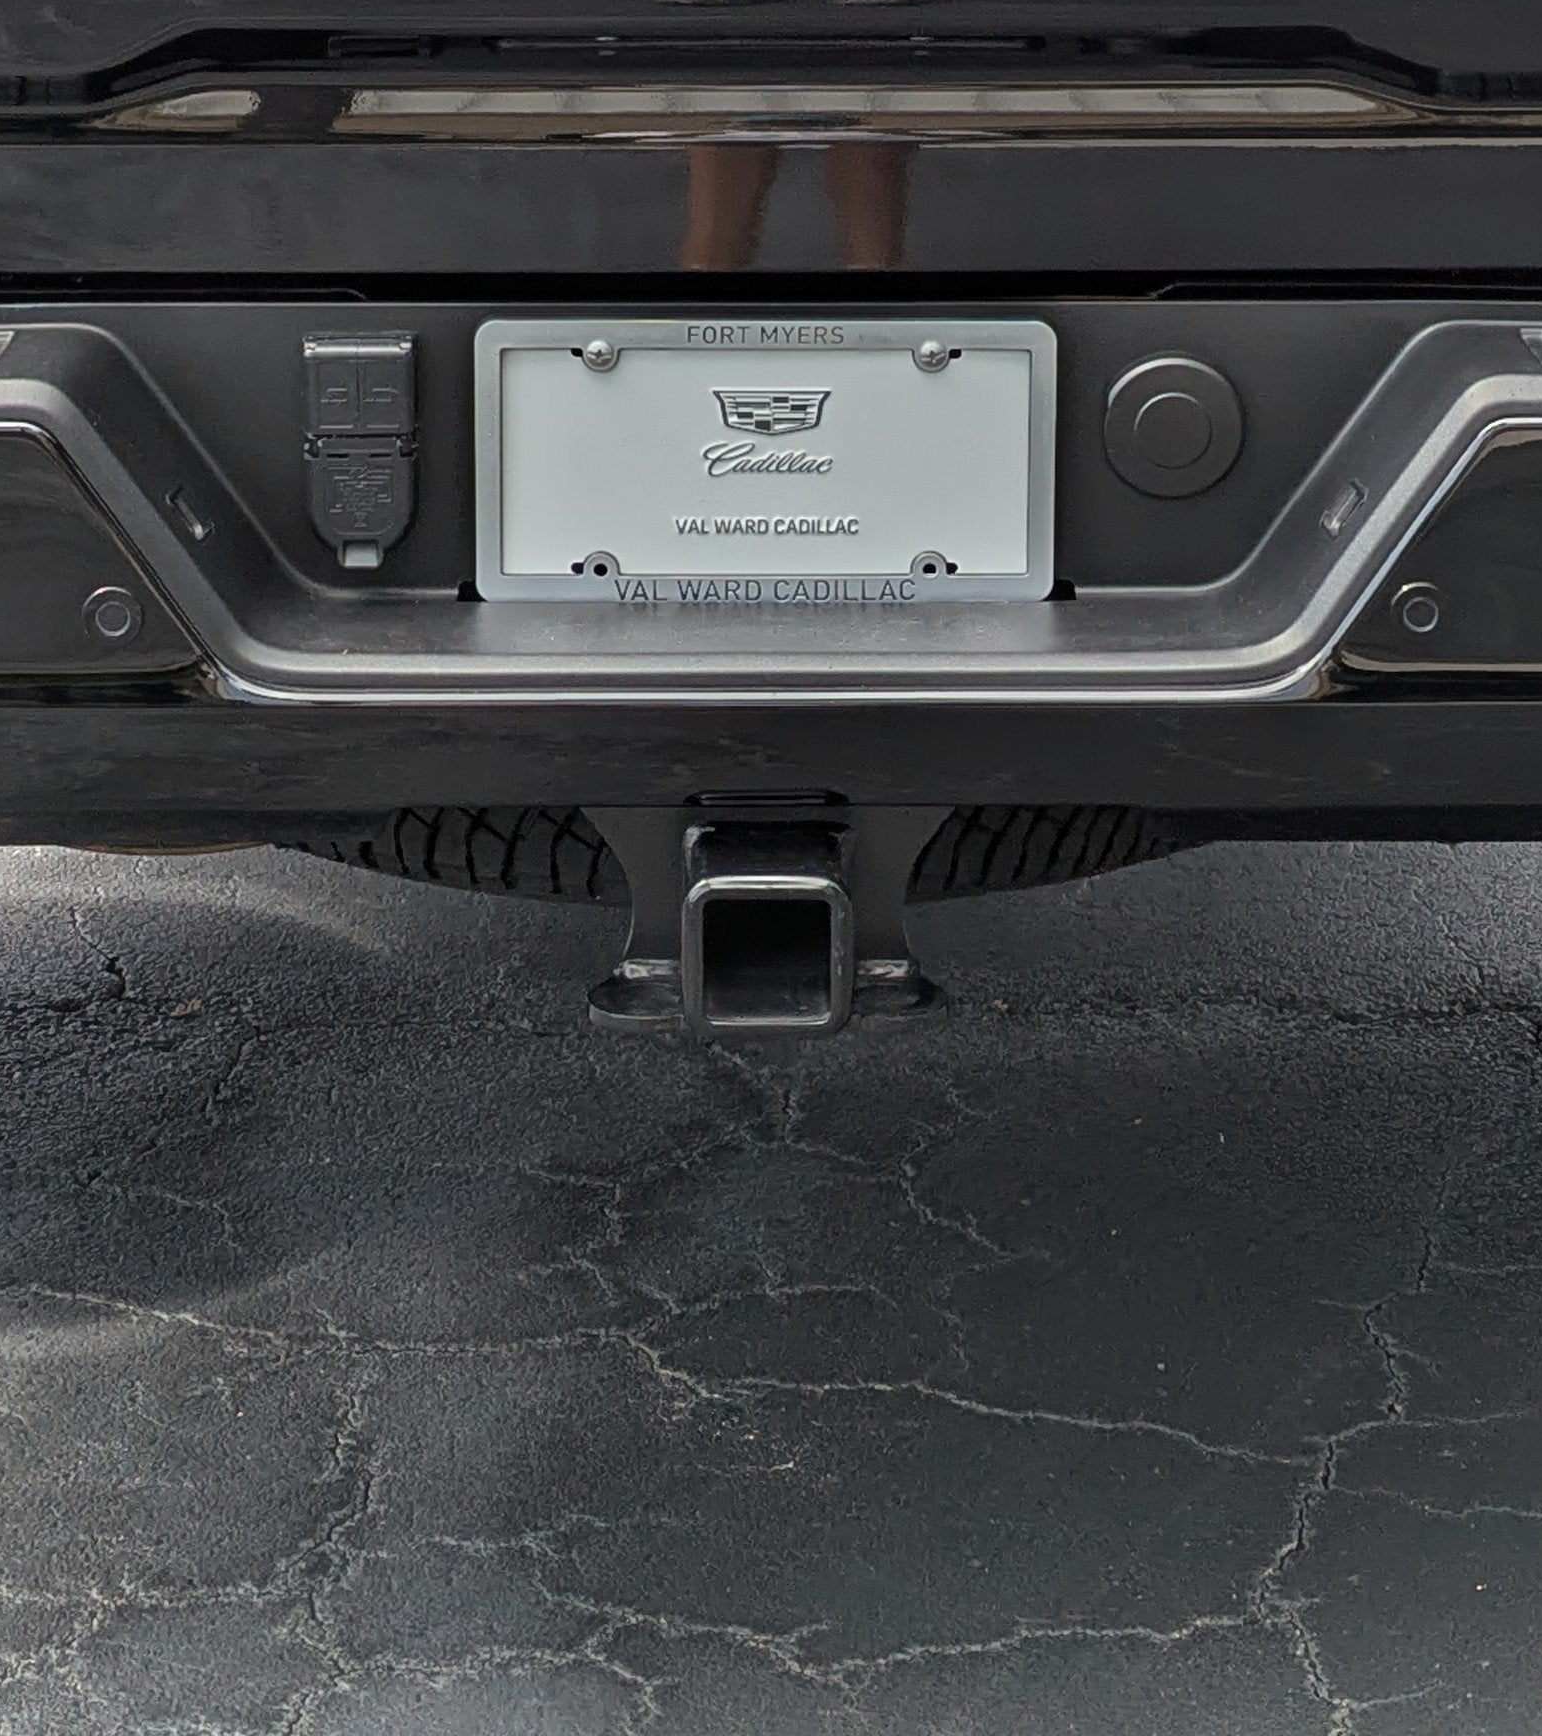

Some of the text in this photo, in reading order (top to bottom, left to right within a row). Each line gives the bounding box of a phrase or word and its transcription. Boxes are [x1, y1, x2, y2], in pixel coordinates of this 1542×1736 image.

[686, 326, 845, 345] FORT MYERS
[702, 443, 834, 478] Cadillac
[675, 519, 859, 535] VAL WARD CADILLAC
[614, 579, 916, 602] VAL WARD CADILLAC
